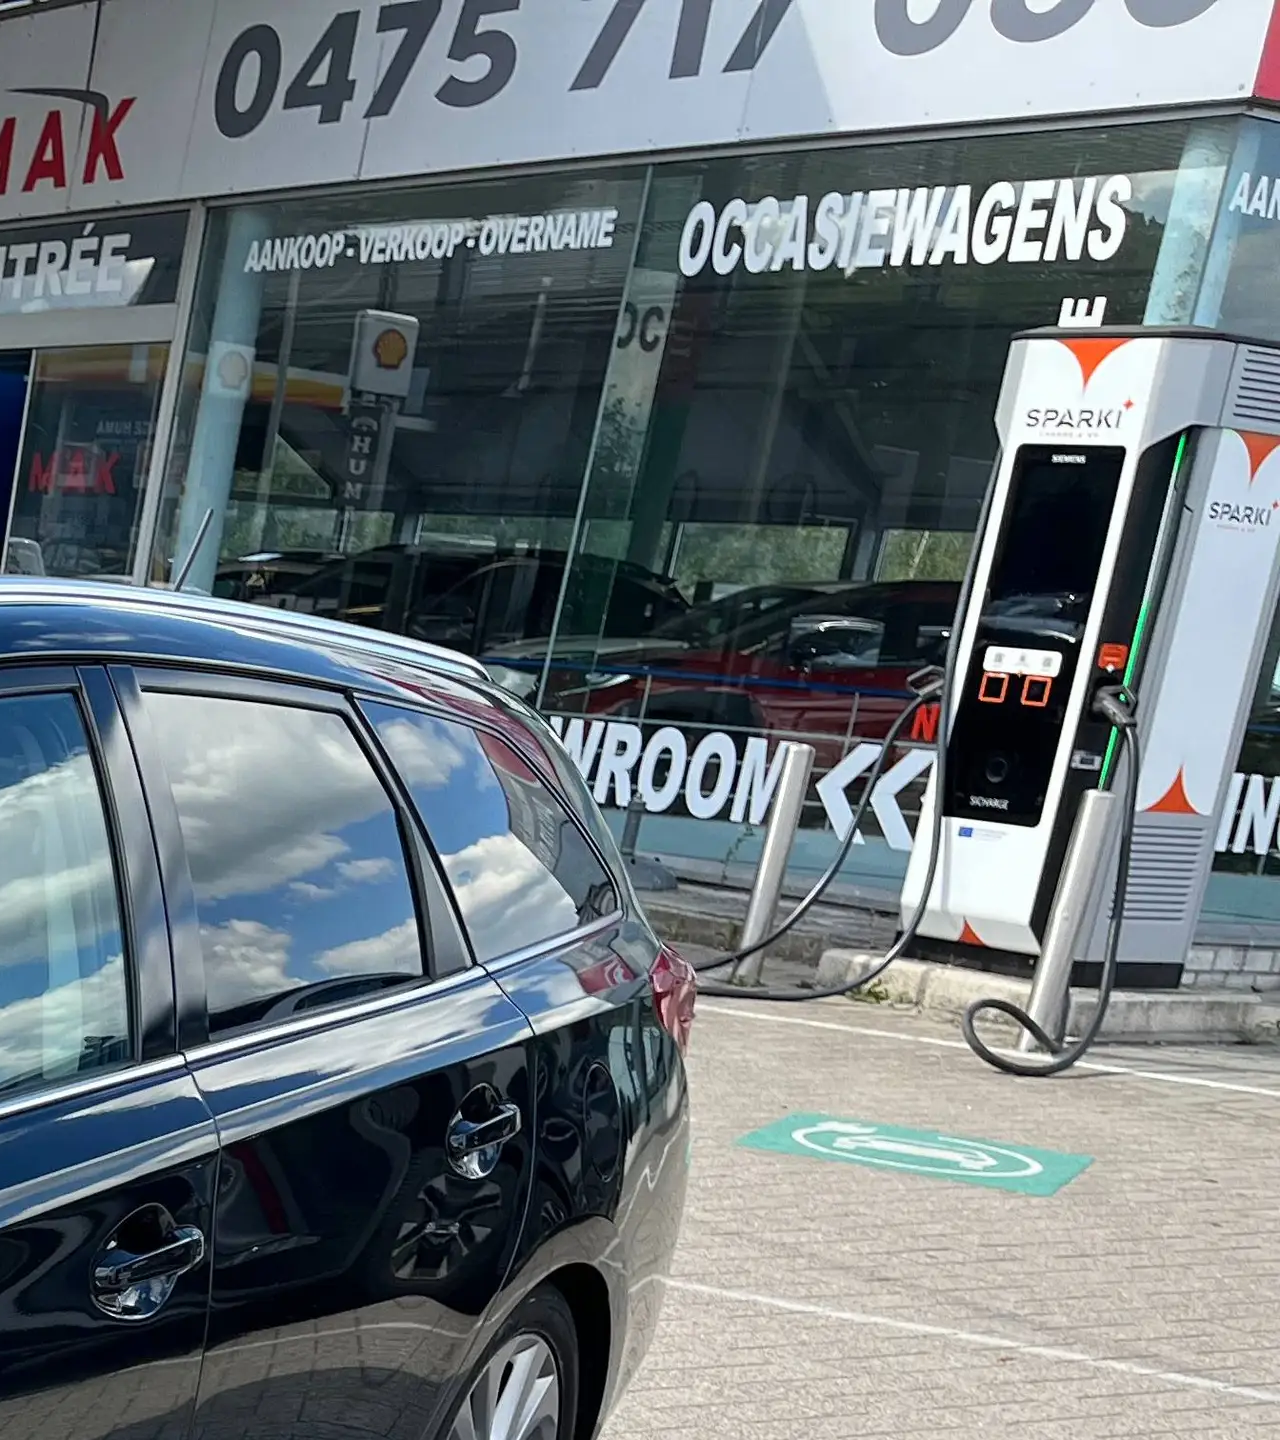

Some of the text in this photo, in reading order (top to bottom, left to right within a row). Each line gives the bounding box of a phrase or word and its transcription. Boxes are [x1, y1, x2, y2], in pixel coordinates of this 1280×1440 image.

[215, 0, 519, 138] 0475
[244, 234, 345, 273] AANKOOP
[359, 222, 465, 265] VERKOOP
[479, 210, 619, 256] OVERNAME
[679, 174, 1132, 277] OCCASIEWAGENS
[1026, 409, 1122, 430] SPARKI
[1209, 502, 1272, 527] SPARKI
